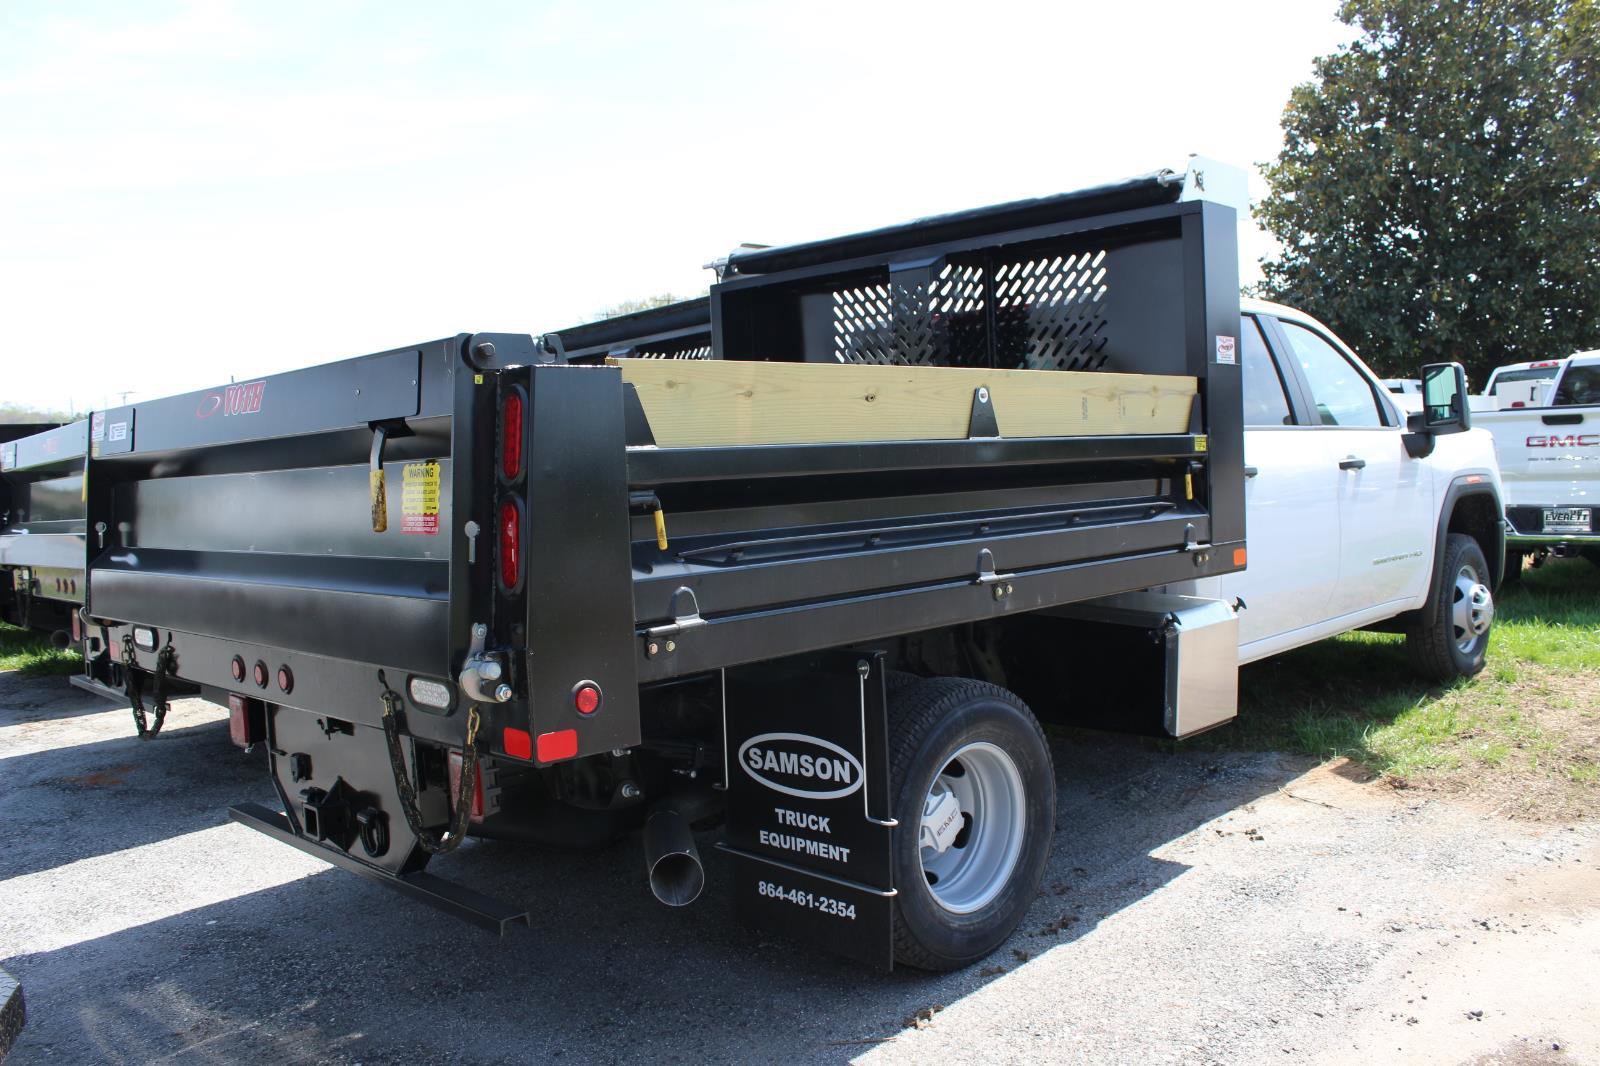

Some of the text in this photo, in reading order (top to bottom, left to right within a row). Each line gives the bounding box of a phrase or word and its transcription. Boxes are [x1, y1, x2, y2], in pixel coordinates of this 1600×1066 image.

[1526, 434, 1600, 448] GMC
[409, 467, 434, 478] WARNING
[1545, 513, 1588, 521] EVERETT
[749, 747, 851, 784] SAMSON
[774, 807, 831, 834] TRUCK
[936, 808, 959, 837] GMC
[759, 830, 850, 863] EQUIPMENT
[758, 880, 856, 920] 864-461-2354
